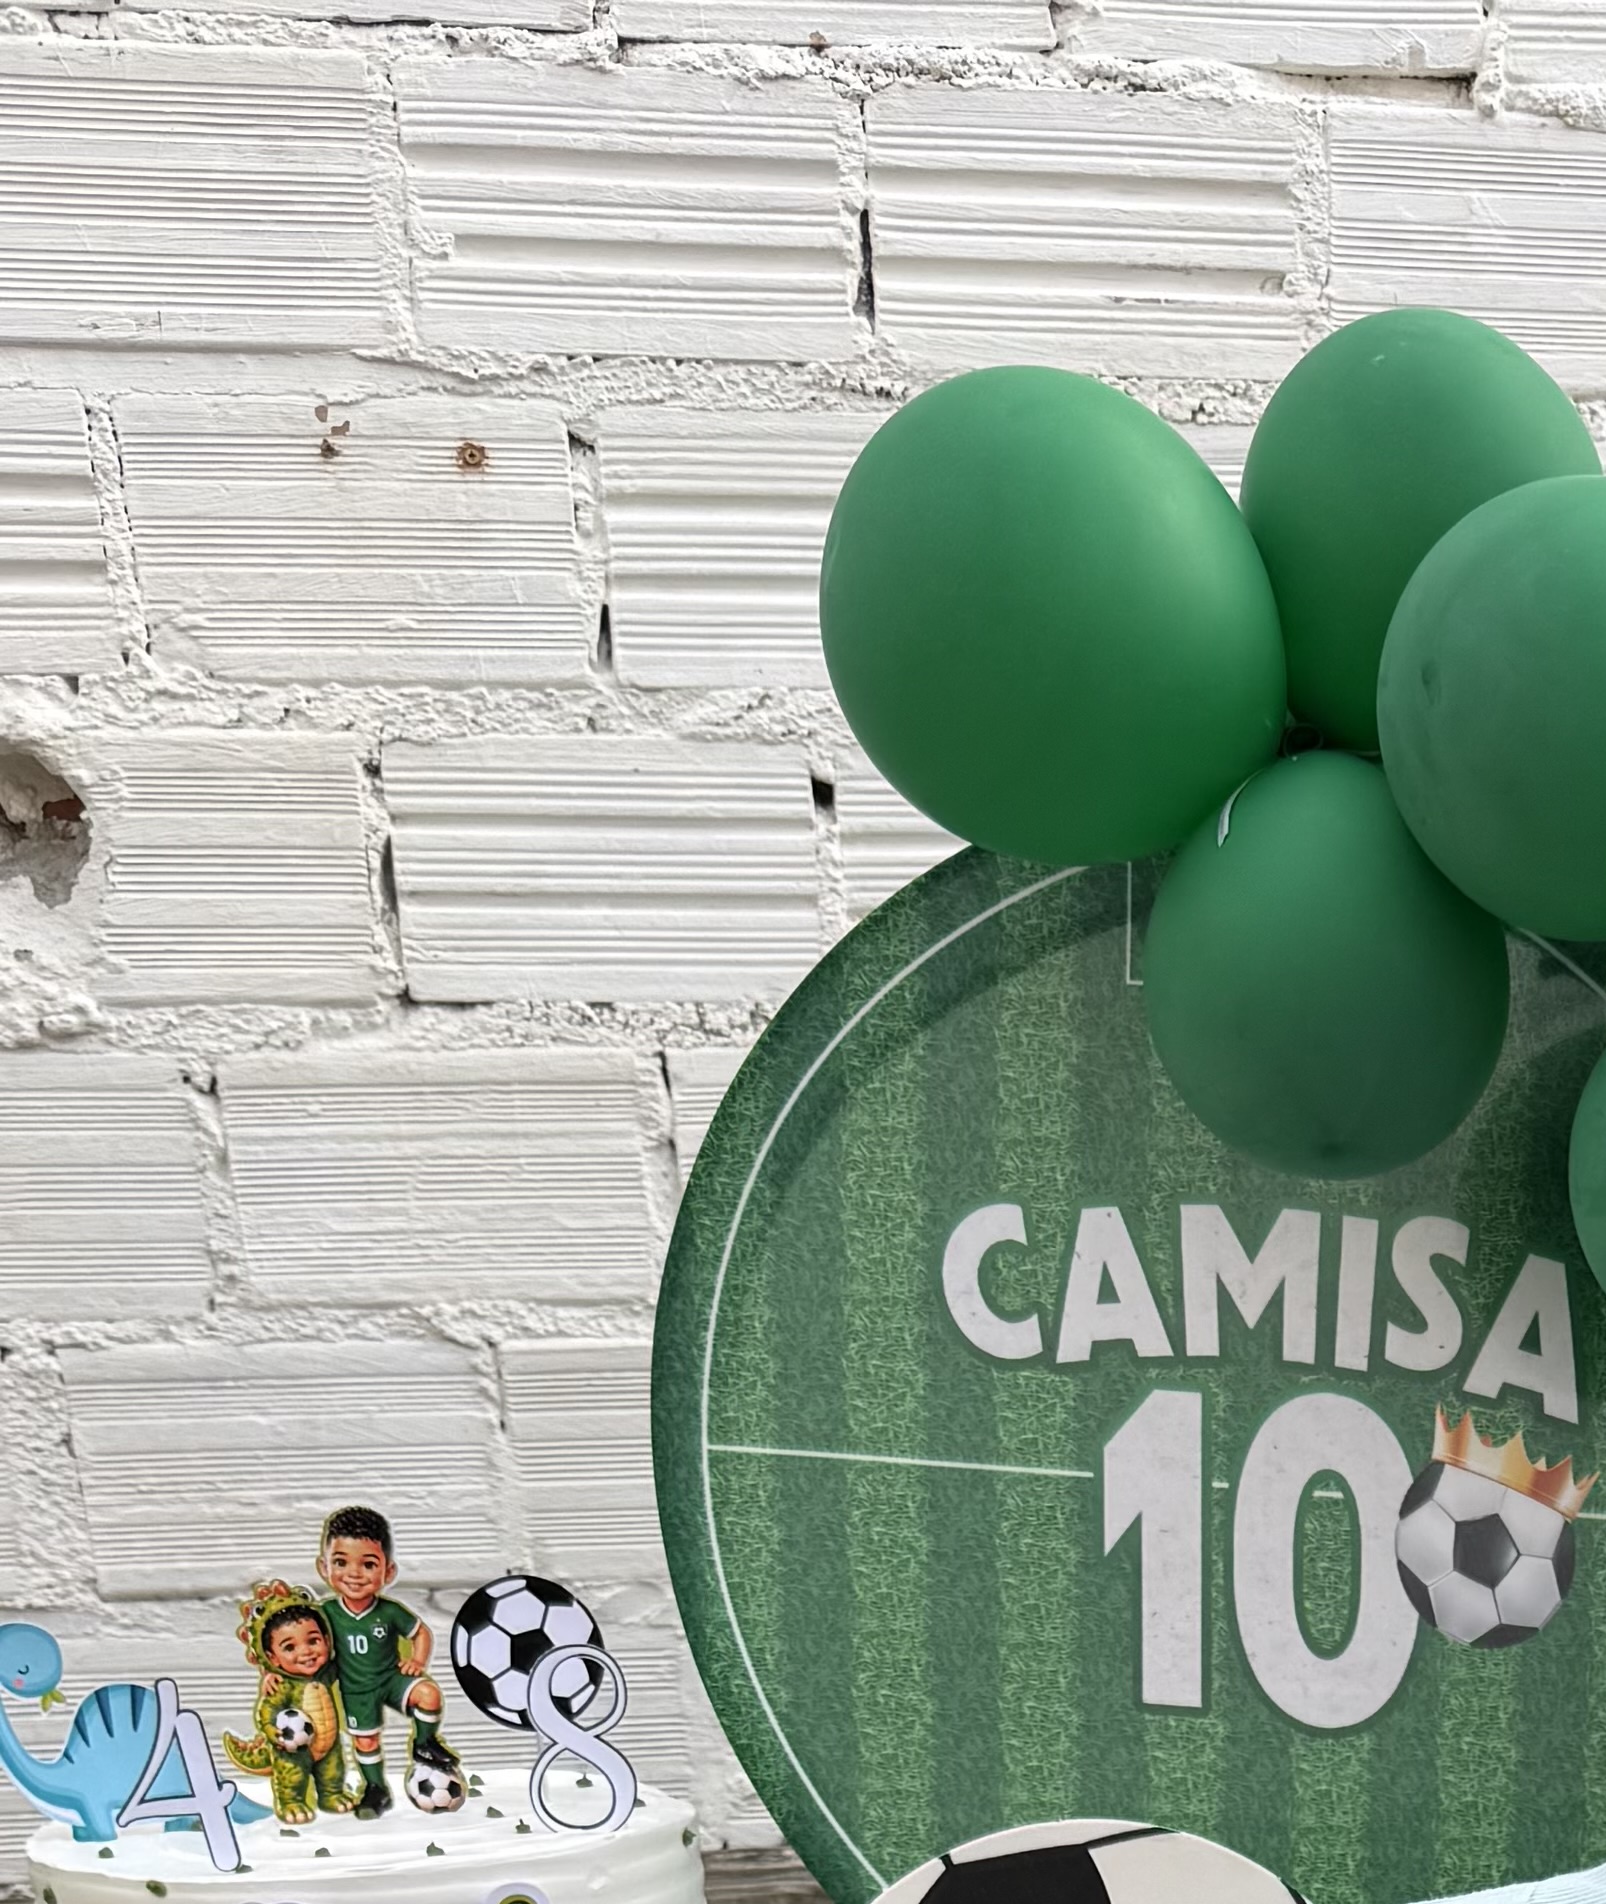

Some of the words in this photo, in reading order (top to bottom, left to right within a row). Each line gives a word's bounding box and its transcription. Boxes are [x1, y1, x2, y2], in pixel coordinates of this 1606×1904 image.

[942, 1203, 1579, 1424] CAMISA
[347, 1634, 369, 1655] 10
[1103, 1389, 1420, 1729] 10
[117, 1677, 238, 1872] 4
[529, 1643, 639, 1833] 8
